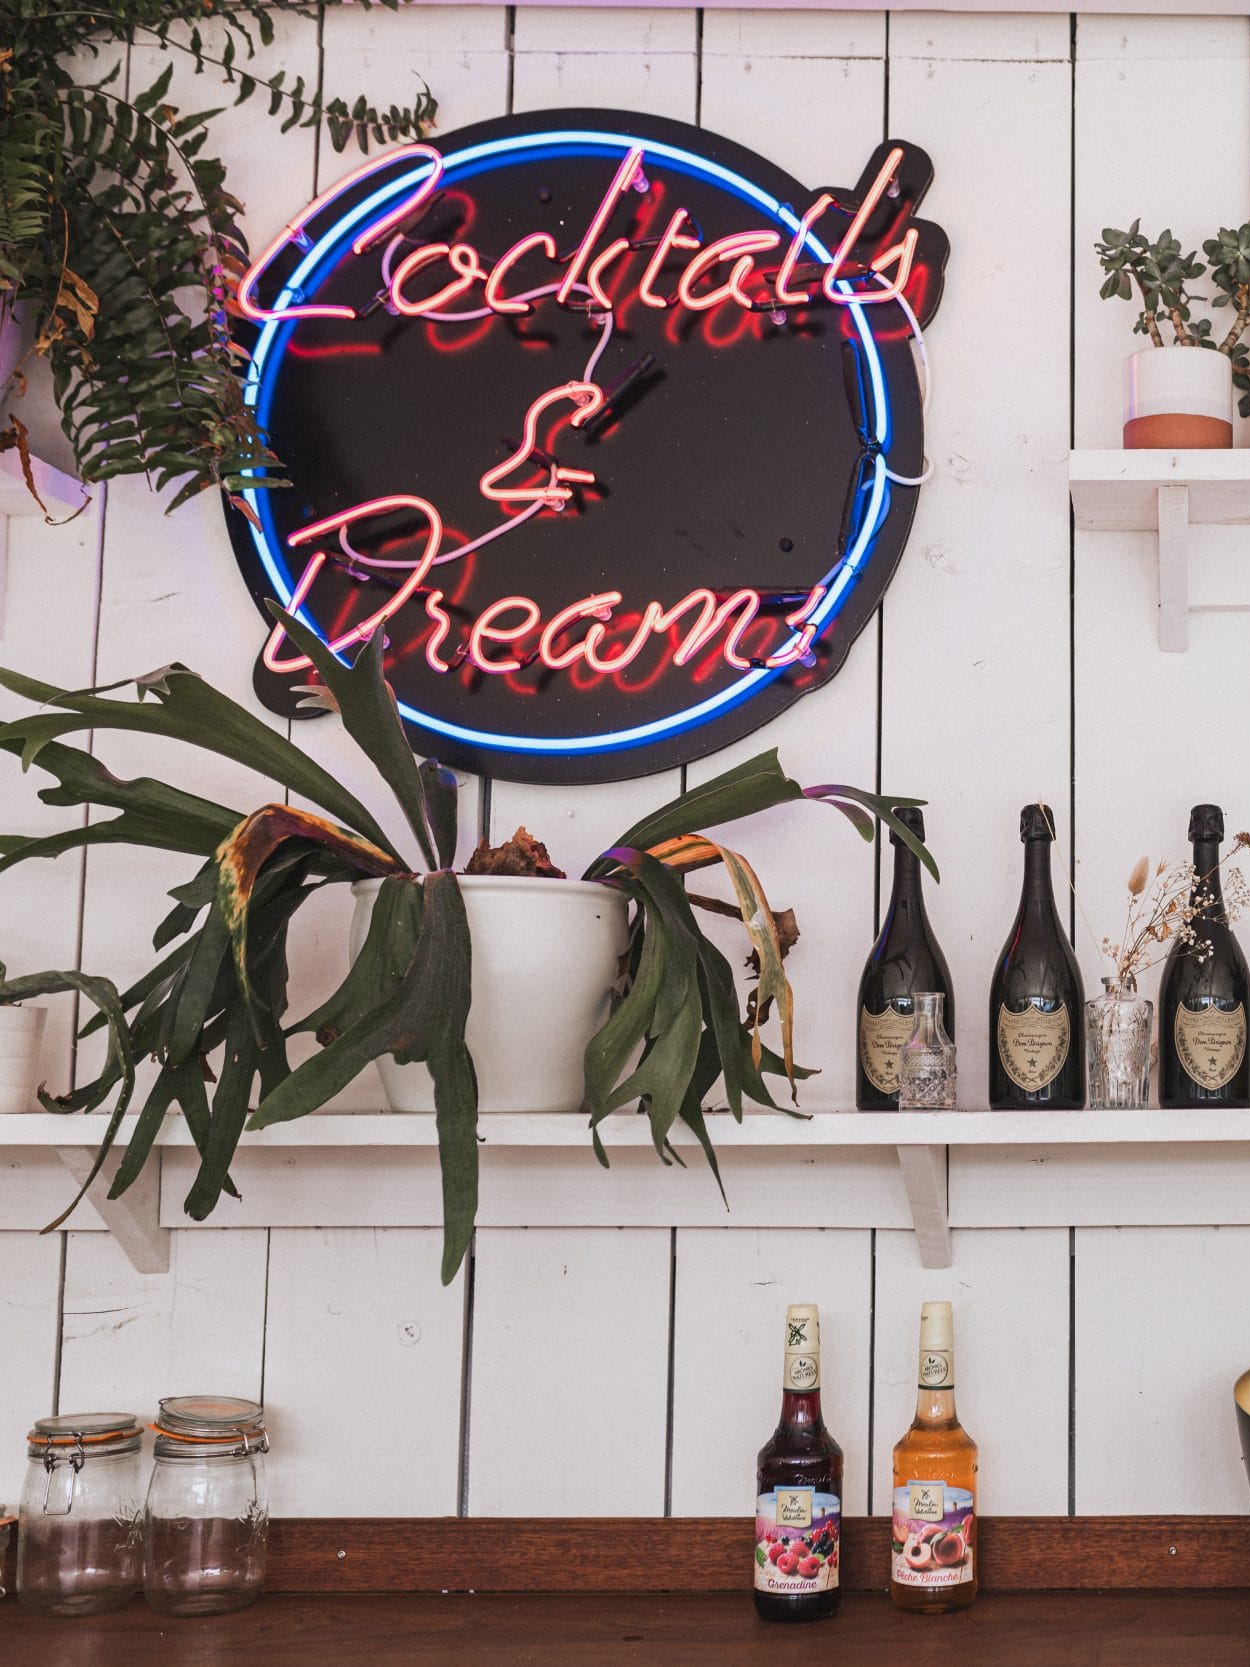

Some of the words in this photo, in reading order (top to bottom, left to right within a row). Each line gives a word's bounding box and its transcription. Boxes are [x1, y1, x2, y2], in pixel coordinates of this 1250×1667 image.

[238, 143, 918, 320] Cocktails
[480, 382, 603, 502] &
[263, 494, 827, 674] Dreams
[871, 1040, 885, 1049] Dom
[1012, 1038, 1027, 1047] Dom
[1192, 1036, 1207, 1046] Dom
[767, 1578, 818, 1590] Grenadine
